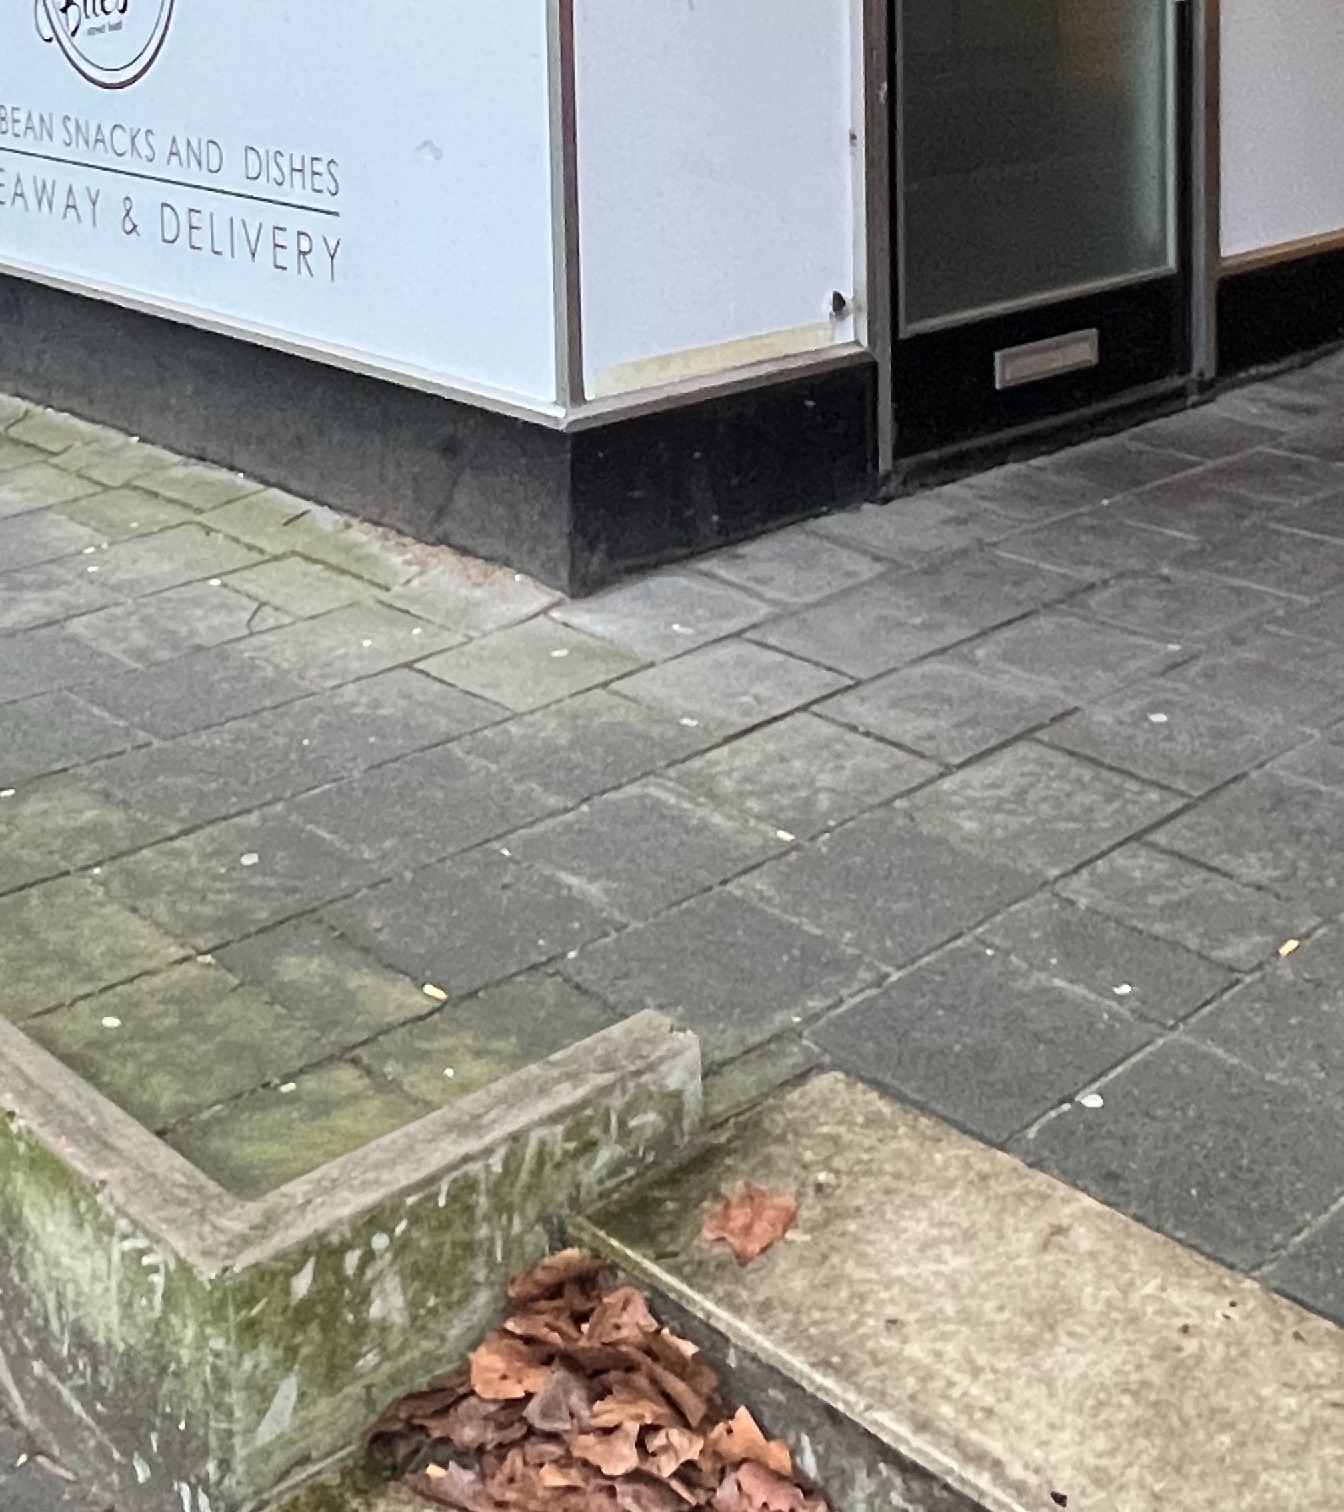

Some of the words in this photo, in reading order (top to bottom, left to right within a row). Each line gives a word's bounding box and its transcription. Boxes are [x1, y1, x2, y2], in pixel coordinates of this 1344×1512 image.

[62, 115, 155, 162] SNACKS
[166, 135, 223, 174] AND
[244, 145, 339, 196] DISHES
[122, 196, 140, 237] &
[160, 203, 341, 282] DELIVERY
